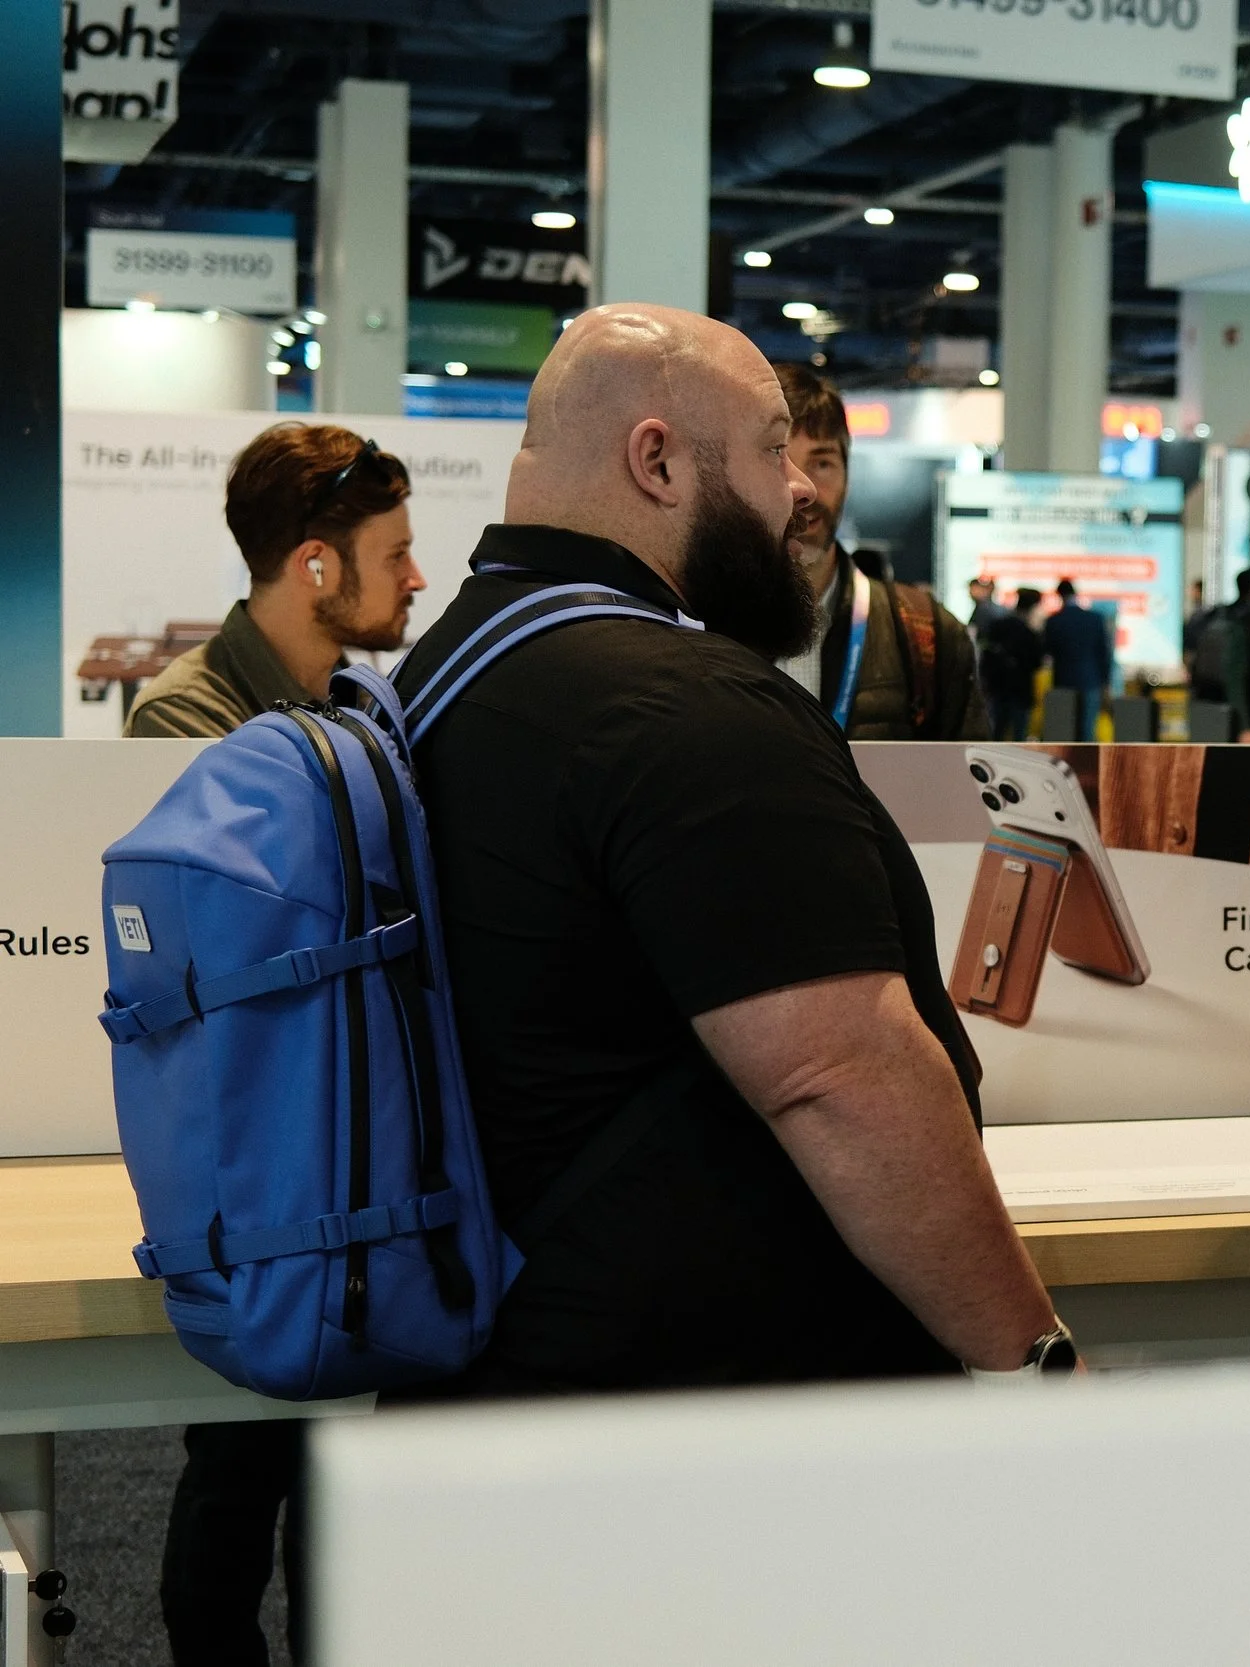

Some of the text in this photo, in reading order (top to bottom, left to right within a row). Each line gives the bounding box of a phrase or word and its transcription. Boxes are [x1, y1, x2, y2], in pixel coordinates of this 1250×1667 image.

[79, 442, 132, 467] The
[0, 926, 90, 956] Rules
[118, 917, 144, 940] YETI
